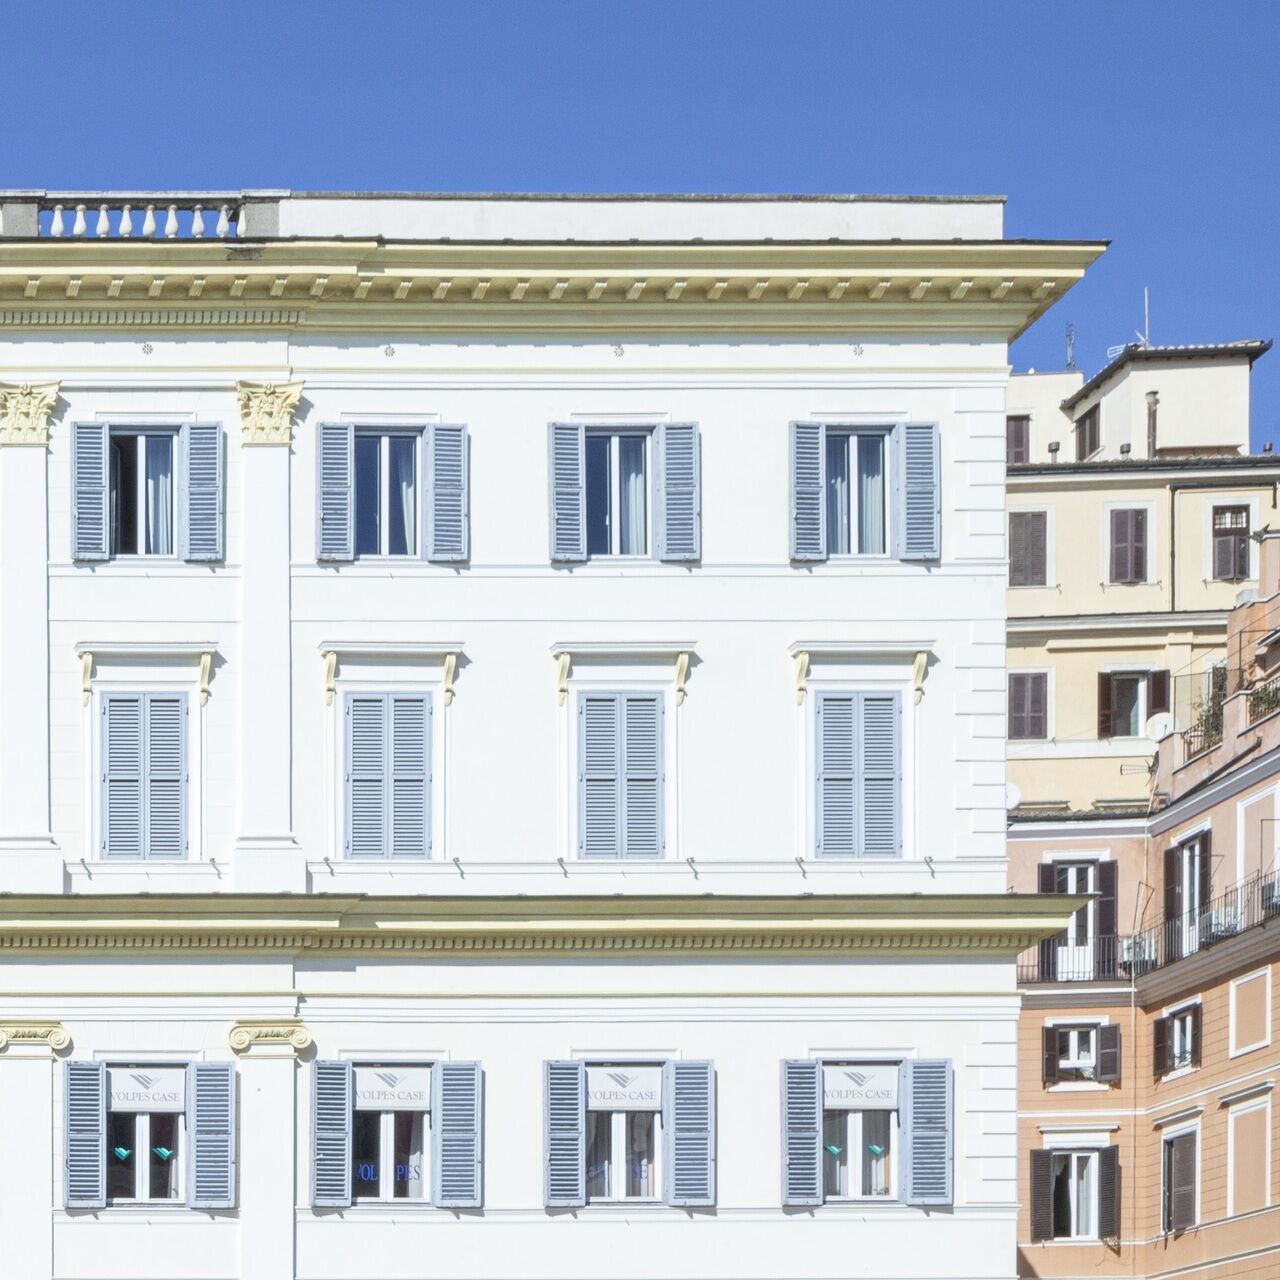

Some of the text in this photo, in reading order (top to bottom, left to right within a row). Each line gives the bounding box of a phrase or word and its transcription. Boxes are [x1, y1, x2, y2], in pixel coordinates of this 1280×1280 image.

[110, 1092, 180, 1102] VOLPES CASE
[356, 1091, 425, 1101] VOLPES CASE
[588, 1091, 656, 1101] VOLPES CASE
[825, 1089, 893, 1099] VOLPES CASE
